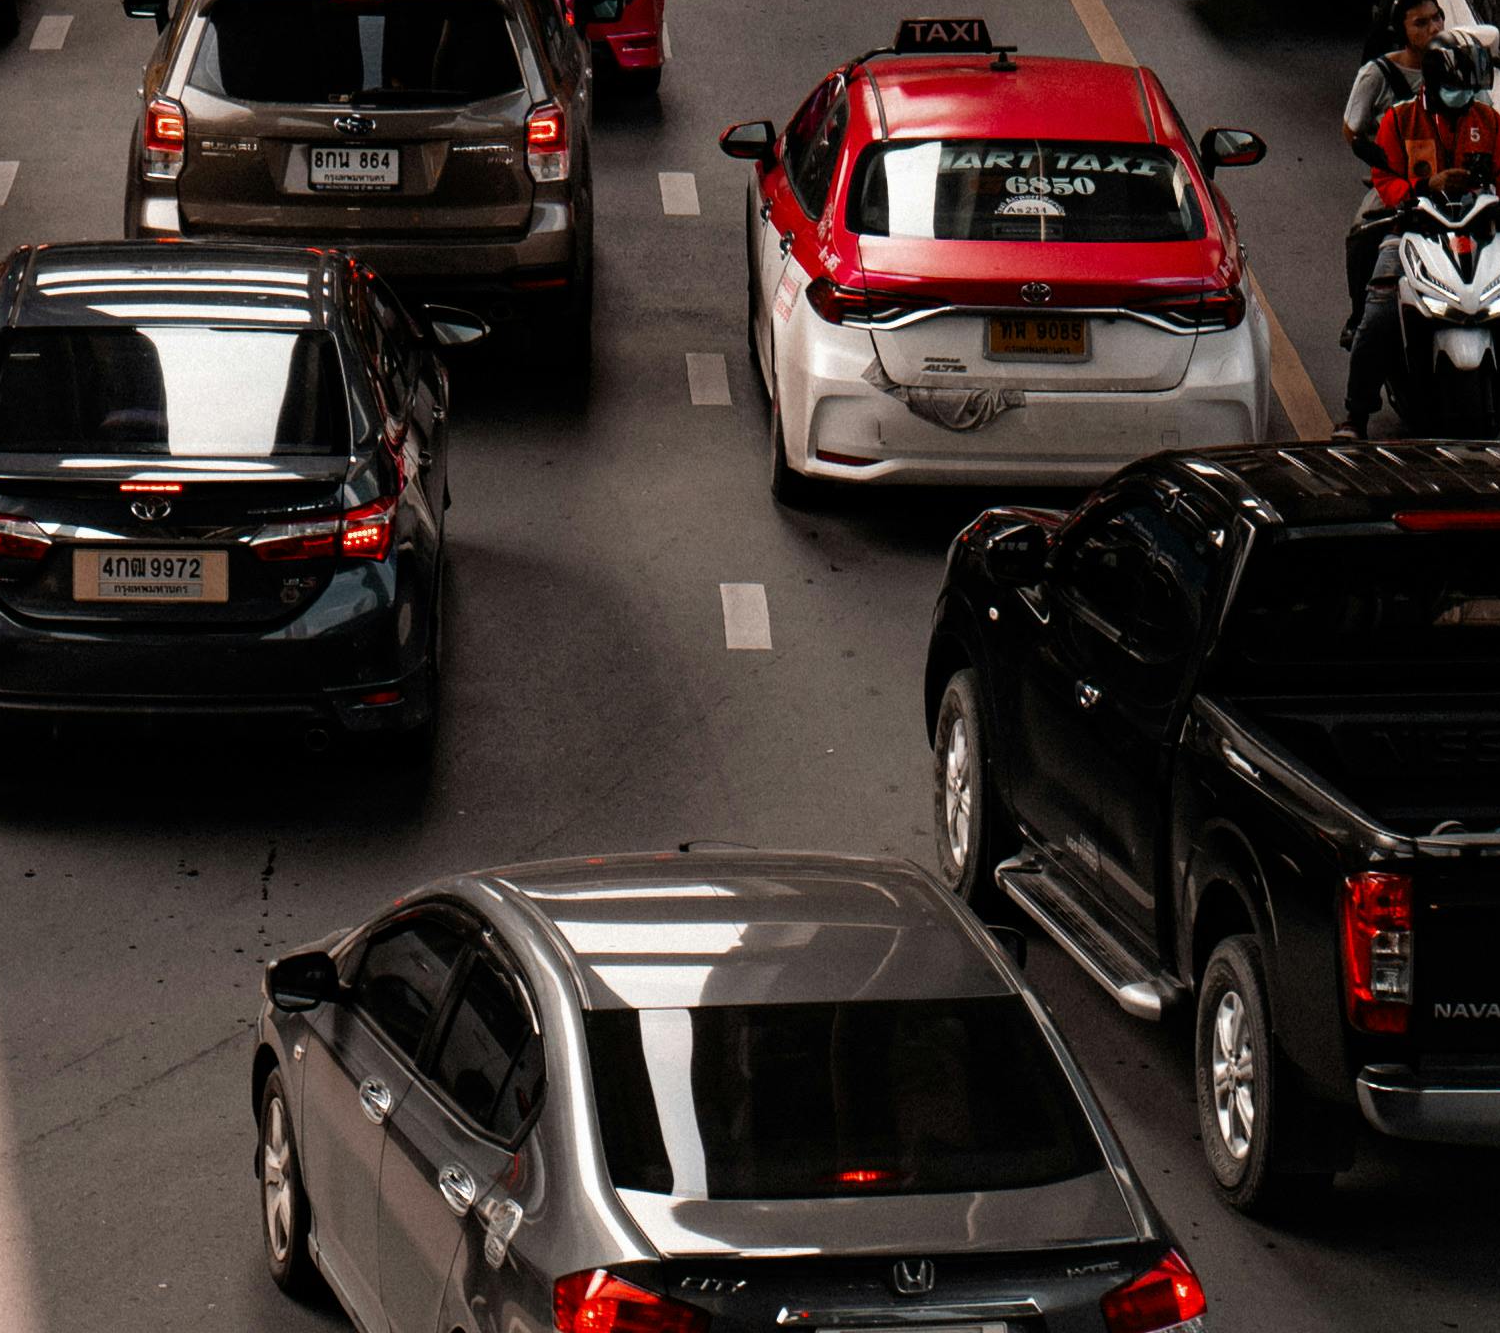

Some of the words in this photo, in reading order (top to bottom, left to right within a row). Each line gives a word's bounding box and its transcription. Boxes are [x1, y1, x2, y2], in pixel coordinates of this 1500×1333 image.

[907, 21, 982, 43] TAXI
[1470, 127, 1481, 143] 5
[359, 151, 392, 170] 864
[1053, 149, 1159, 177] TAXI
[1004, 176, 1097, 196] 6850
[149, 556, 203, 581] 9972
